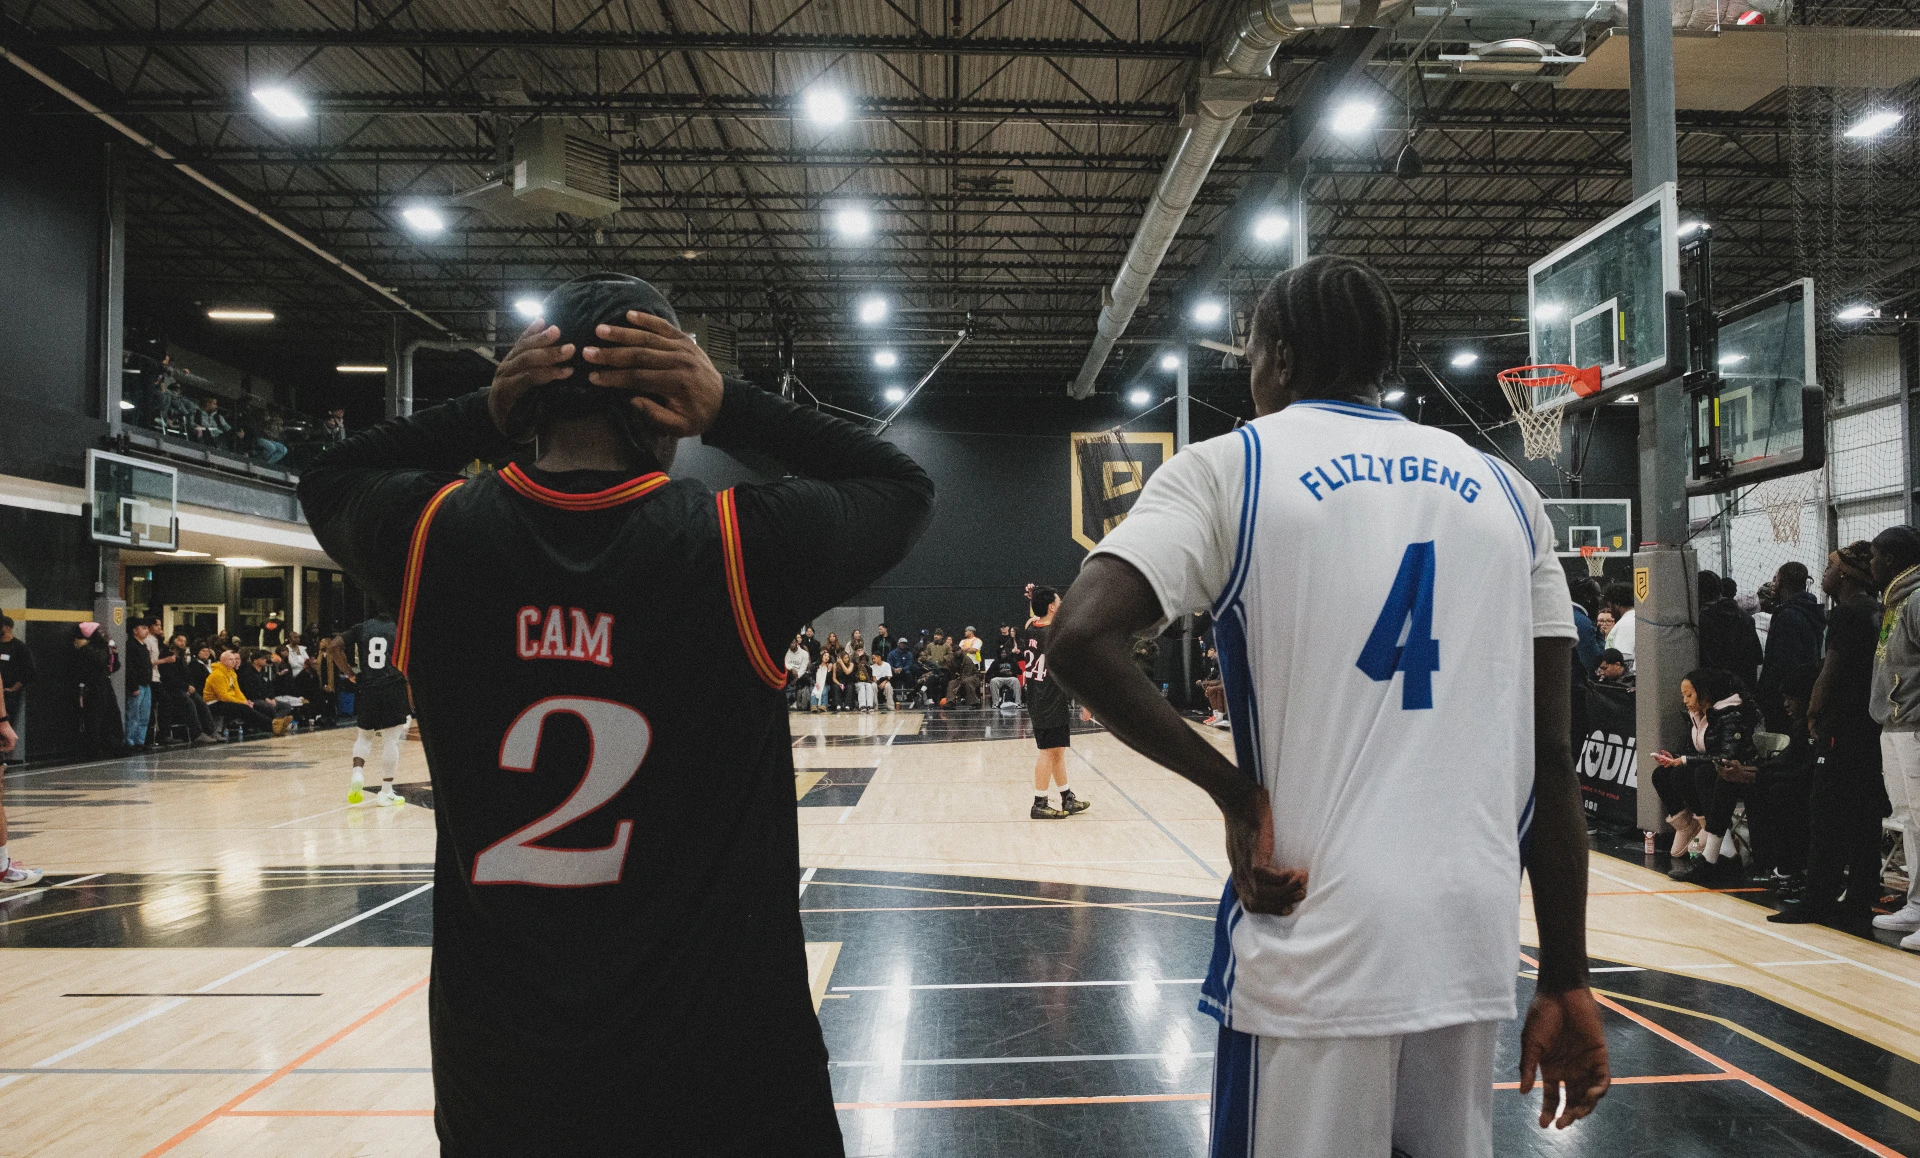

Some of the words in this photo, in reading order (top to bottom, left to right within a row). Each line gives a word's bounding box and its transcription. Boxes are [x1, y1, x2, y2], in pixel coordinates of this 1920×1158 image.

[367, 636, 388, 670] 8
[516, 605, 614, 667] CAM
[1355, 539, 1440, 711] 4
[1024, 649, 1048, 682] 24
[472, 695, 652, 888] 2
